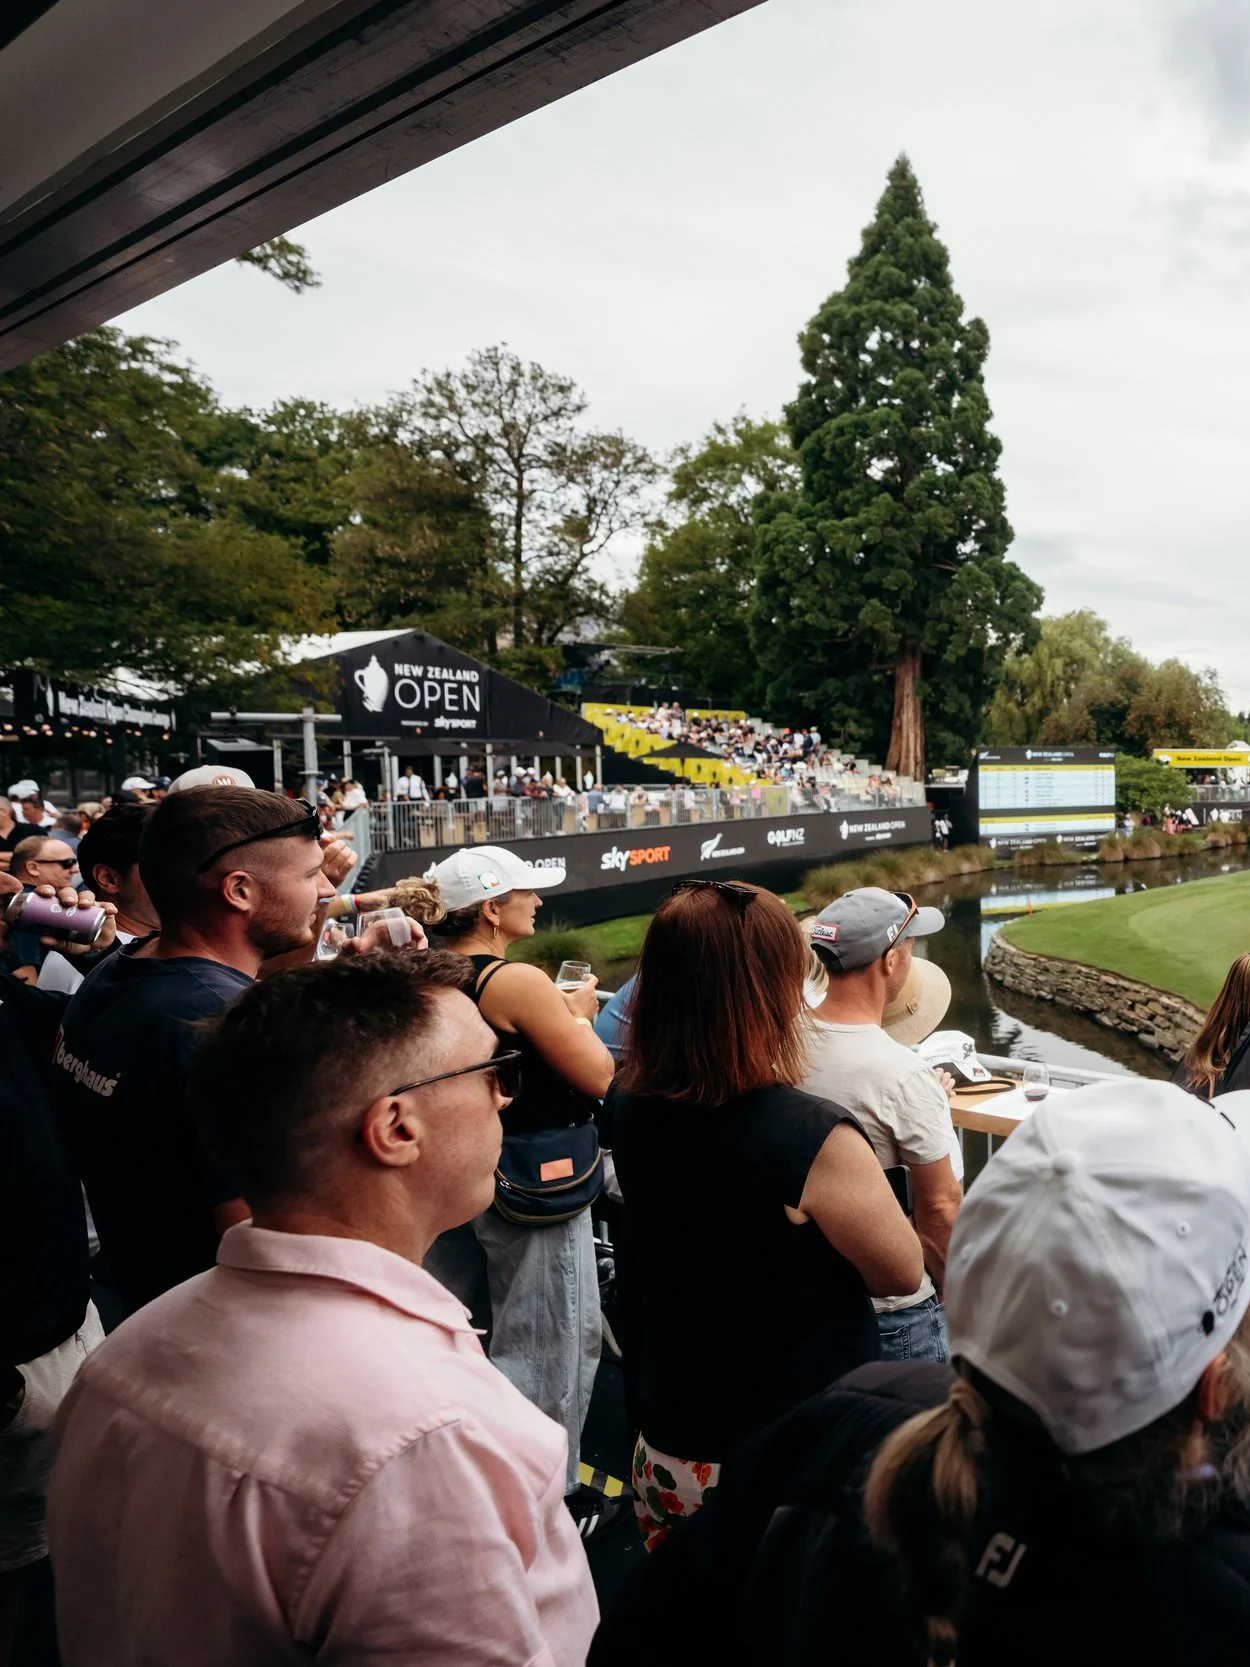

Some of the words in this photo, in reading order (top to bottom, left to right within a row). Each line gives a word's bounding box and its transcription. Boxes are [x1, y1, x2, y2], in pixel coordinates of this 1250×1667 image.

[394, 663, 424, 677] NEW
[426, 666, 480, 682] ZEALAND
[394, 679, 480, 712] OPEN
[601, 846, 671, 872] skySPORT
[56, 1041, 118, 1097] berghaus
